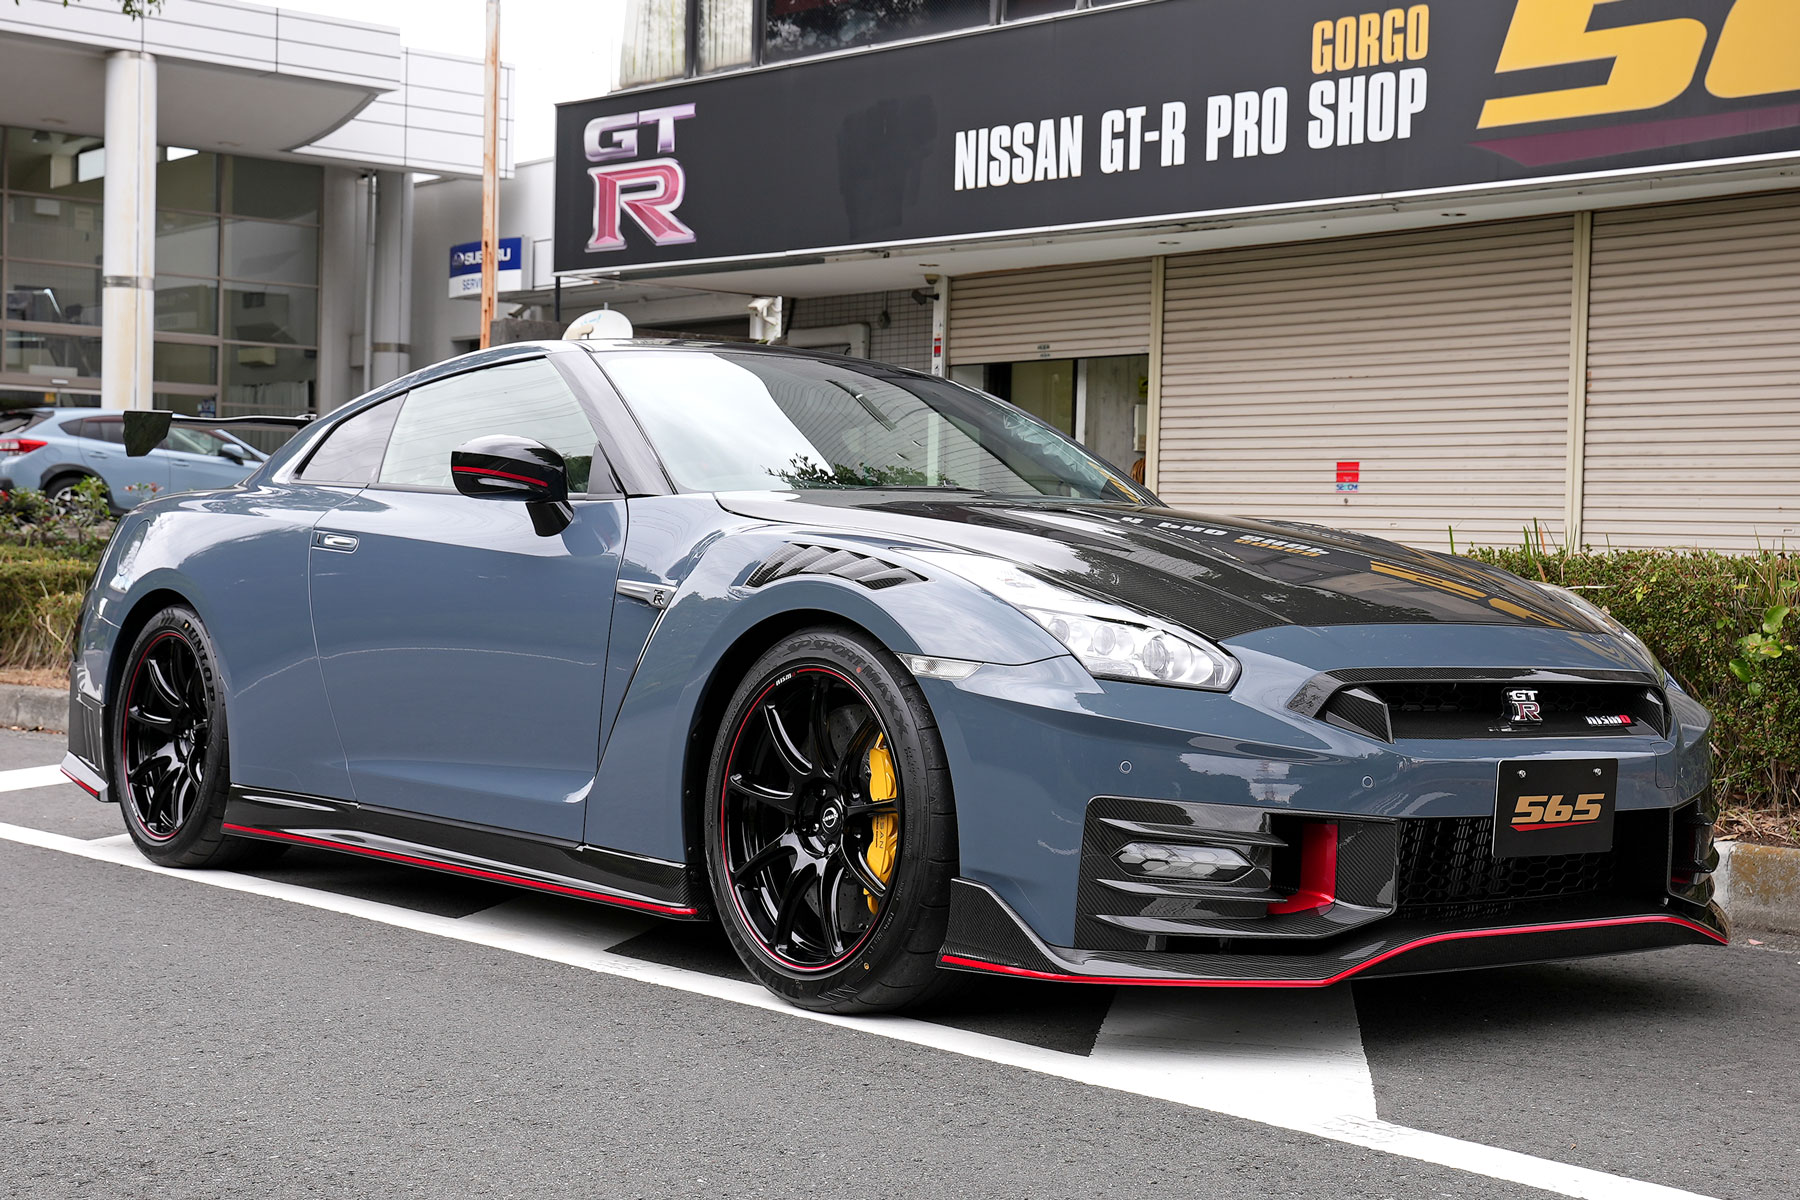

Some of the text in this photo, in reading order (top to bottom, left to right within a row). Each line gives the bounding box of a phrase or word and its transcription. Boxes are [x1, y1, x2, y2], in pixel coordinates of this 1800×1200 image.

[1311, 4, 1429, 75] GORGO
[584, 103, 696, 162] GT
[954, 67, 1427, 191] NISSAN GT-R PRO SHOP
[584, 157, 696, 253] R
[464, 247, 511, 265] SUBU
[182, 619, 216, 702] DUNLOP
[1507, 689, 1539, 701] GT
[1513, 701, 1543, 721] R
[1511, 793, 1605, 824] 565
